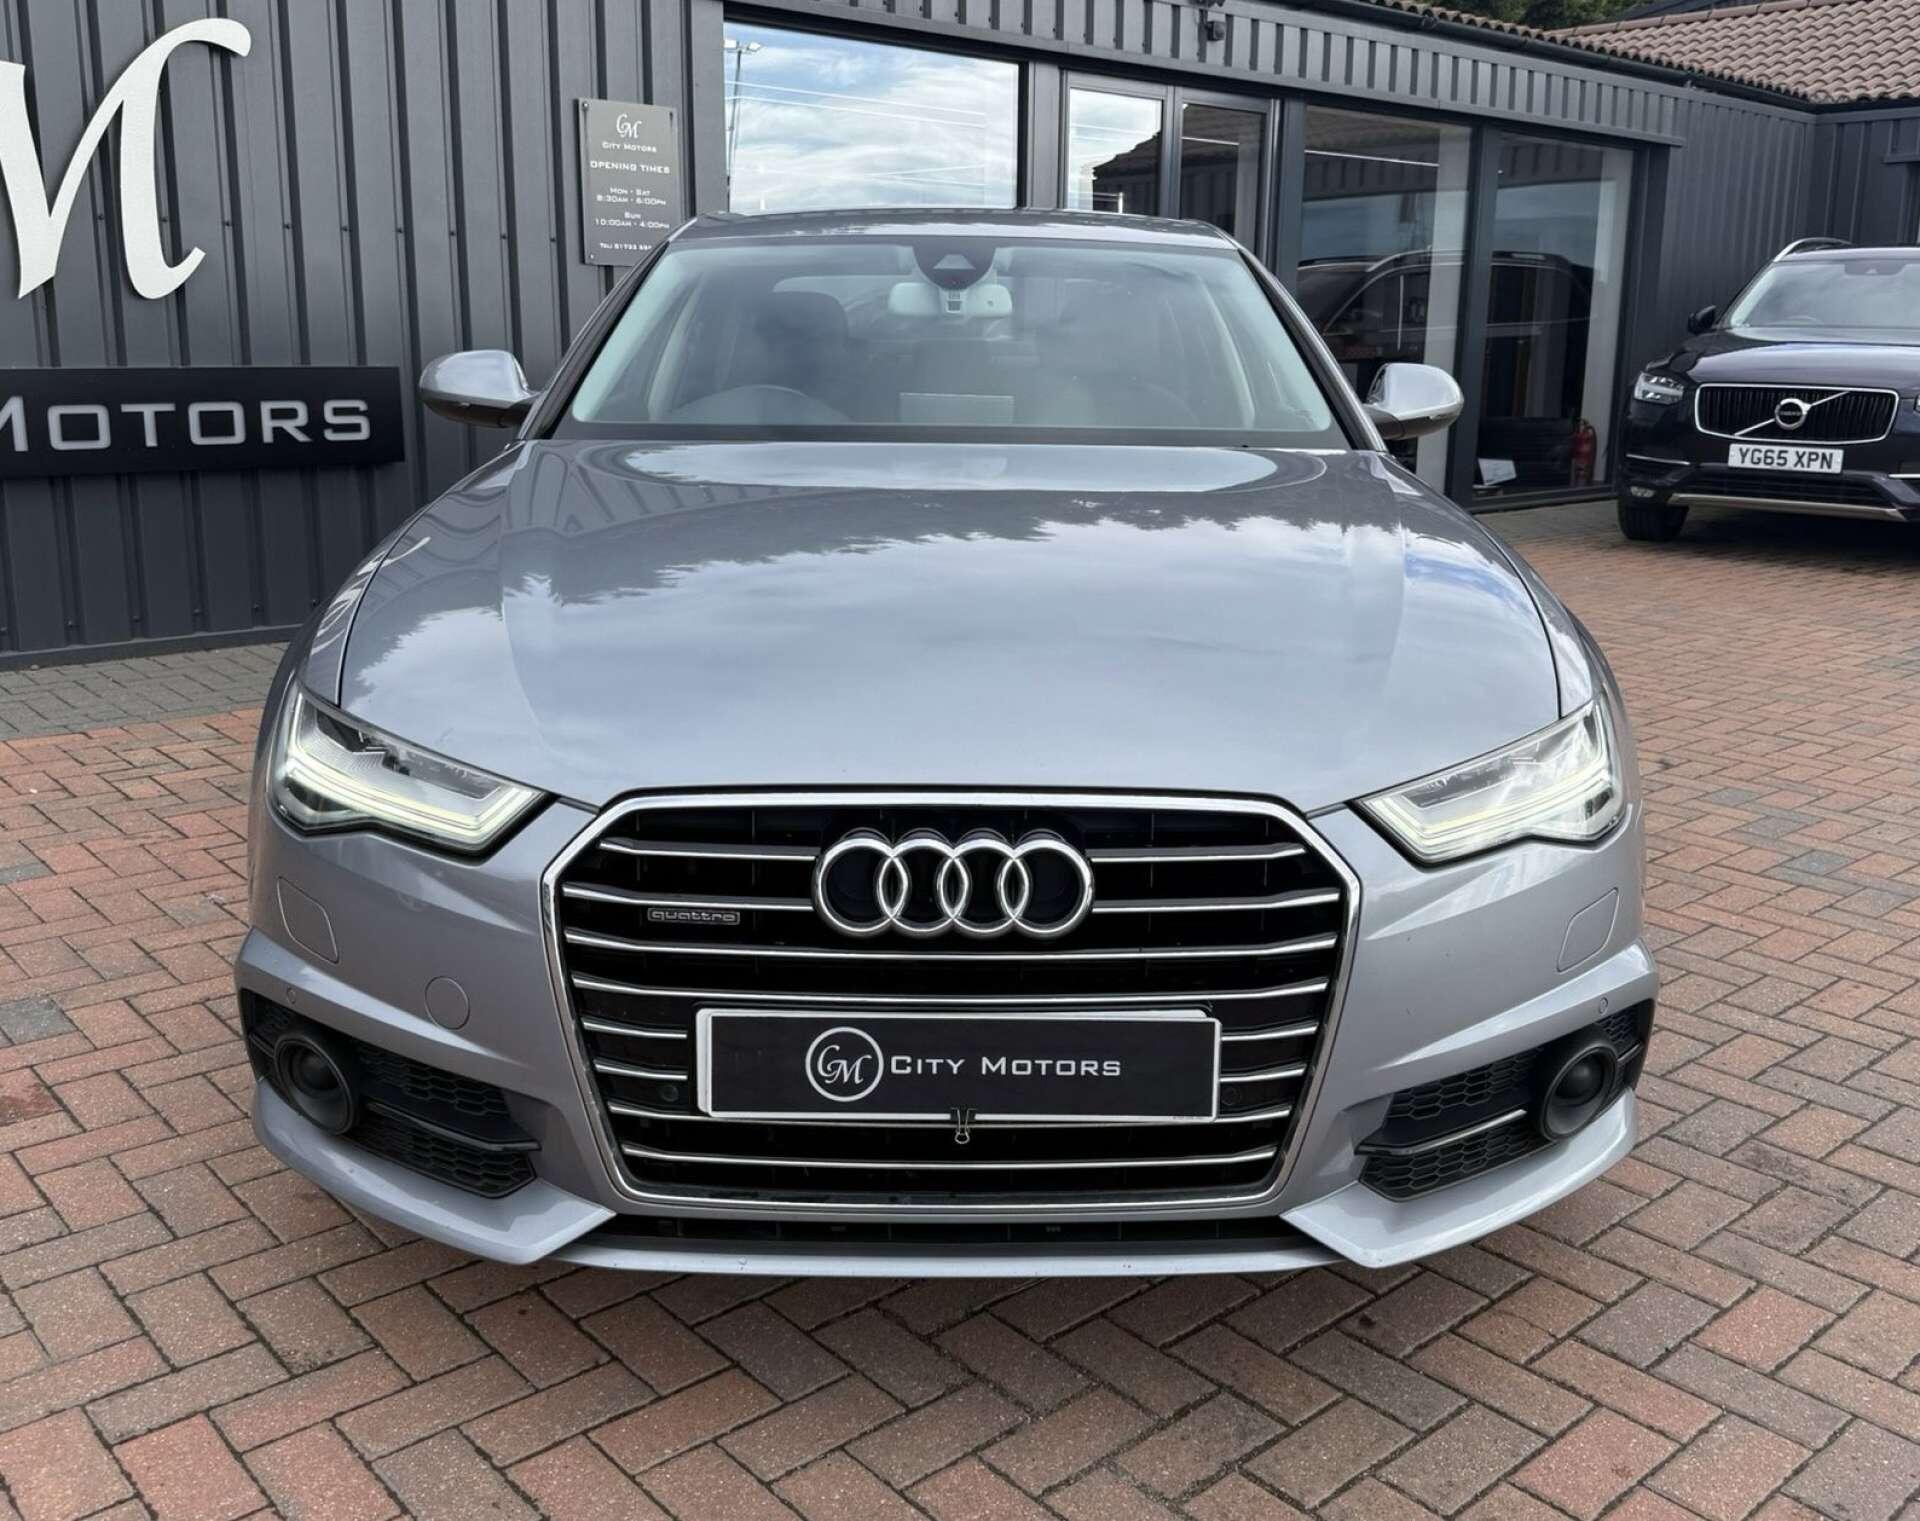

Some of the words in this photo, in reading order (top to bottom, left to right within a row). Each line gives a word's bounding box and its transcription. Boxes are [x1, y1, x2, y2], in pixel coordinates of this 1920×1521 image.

[590, 160, 637, 172] OPENING
[640, 164, 671, 175] TIMES
[1738, 448, 1788, 468] YG65
[1793, 451, 1834, 470] XPN
[651, 911, 736, 921] quattro
[981, 1056, 1121, 1076] MOTORS
